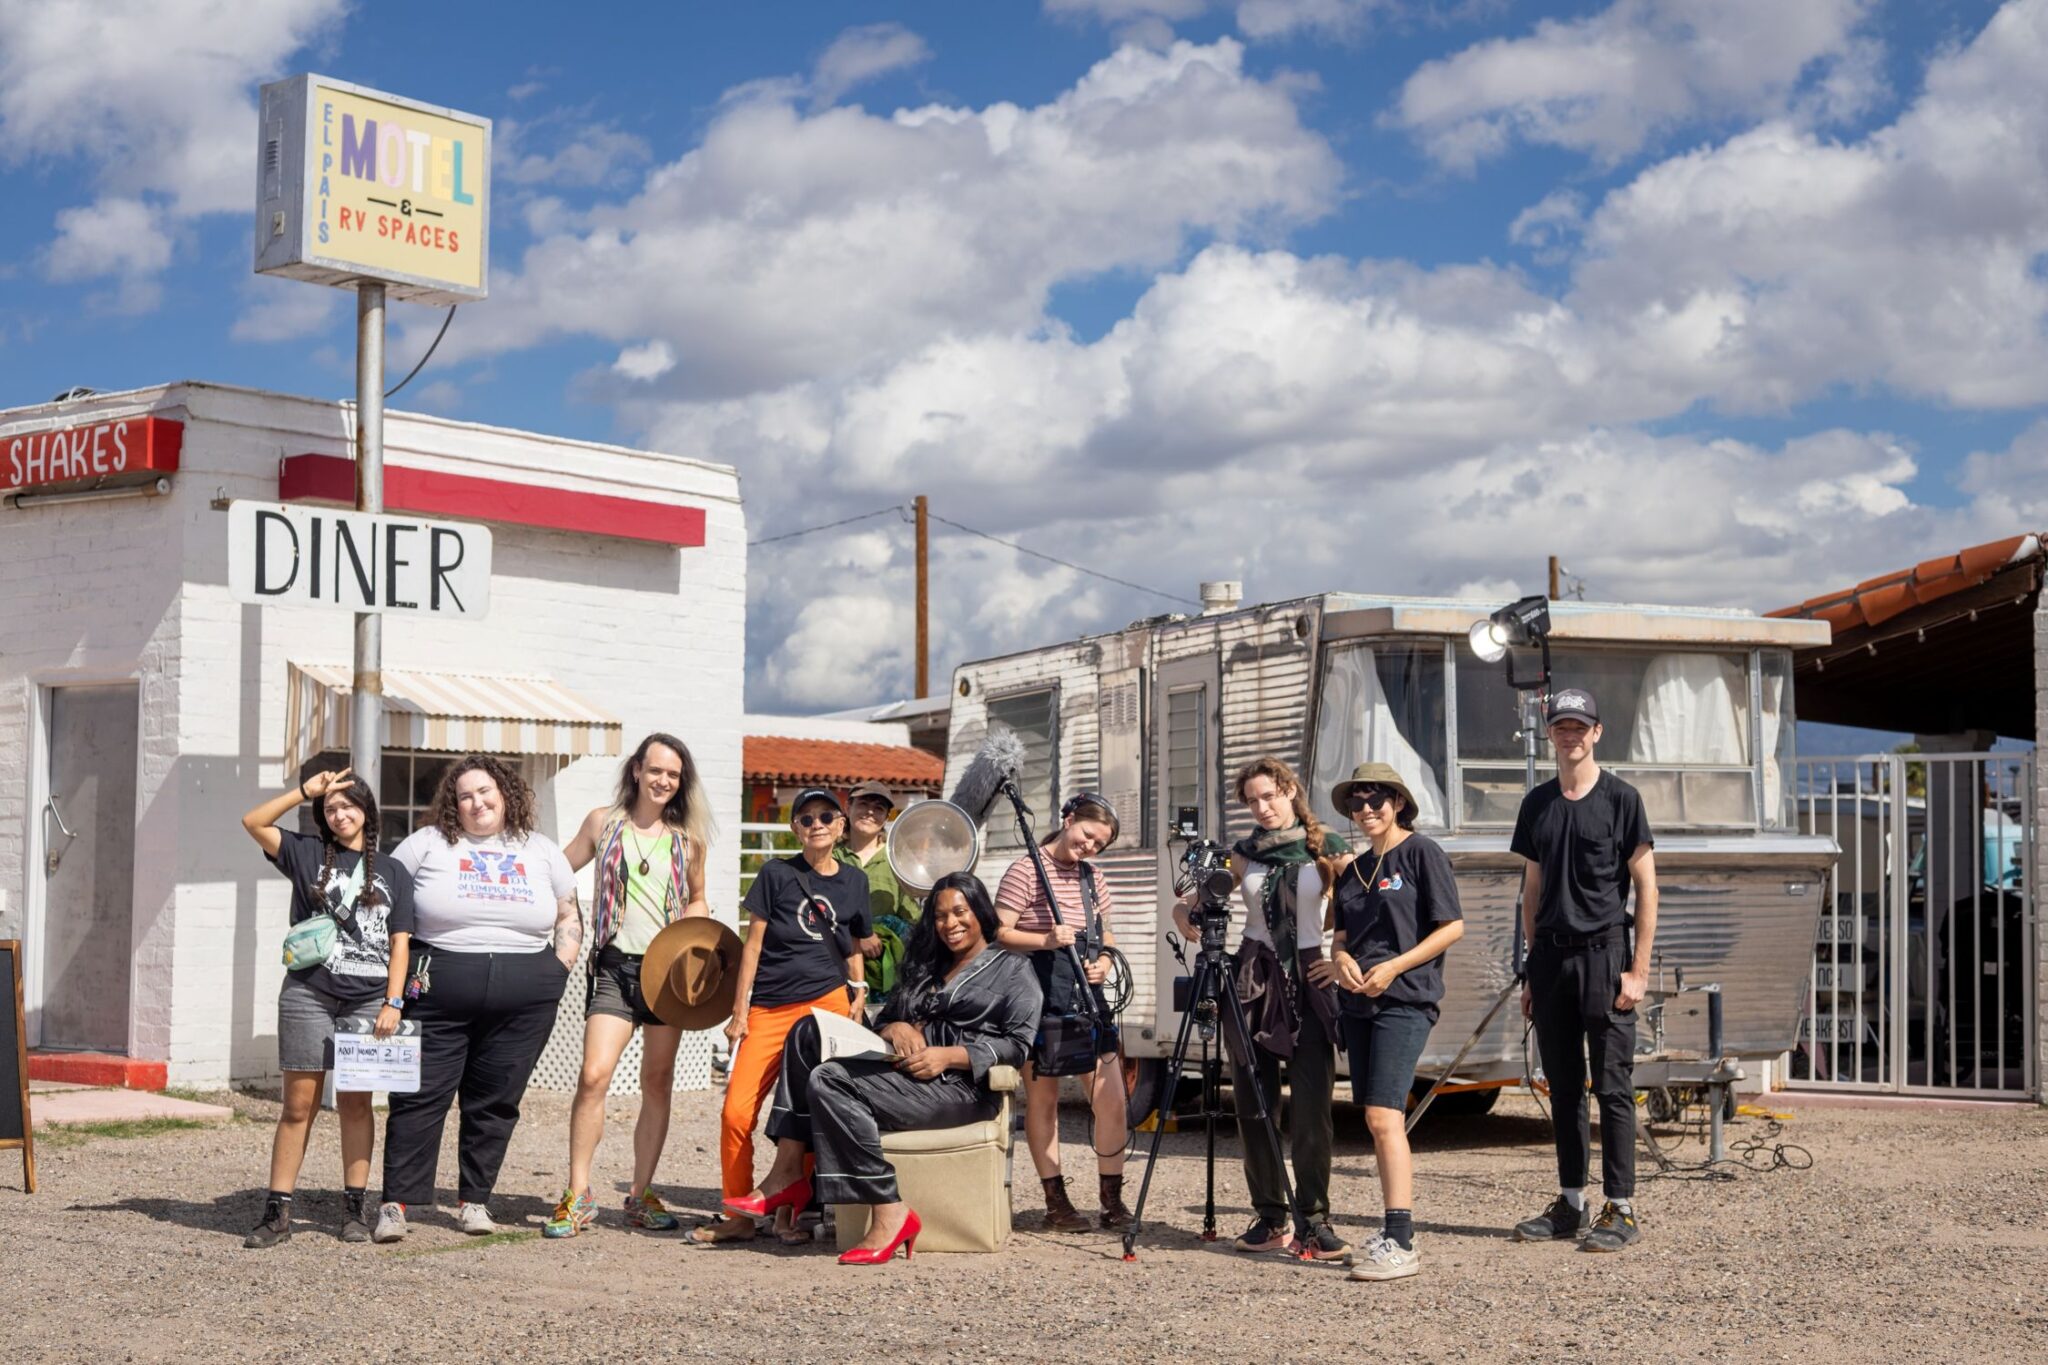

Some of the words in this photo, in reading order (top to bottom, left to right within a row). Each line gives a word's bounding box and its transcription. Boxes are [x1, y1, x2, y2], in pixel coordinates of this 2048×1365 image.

[323, 103, 333, 146] EL
[341, 113, 474, 206] MOTEL
[318, 153, 333, 244] PAIS
[339, 206, 367, 232] RV
[378, 215, 459, 253] SPACES
[400, 199, 412, 216] &
[9, 422, 128, 486] SHAKES
[254, 510, 465, 613] DINER
